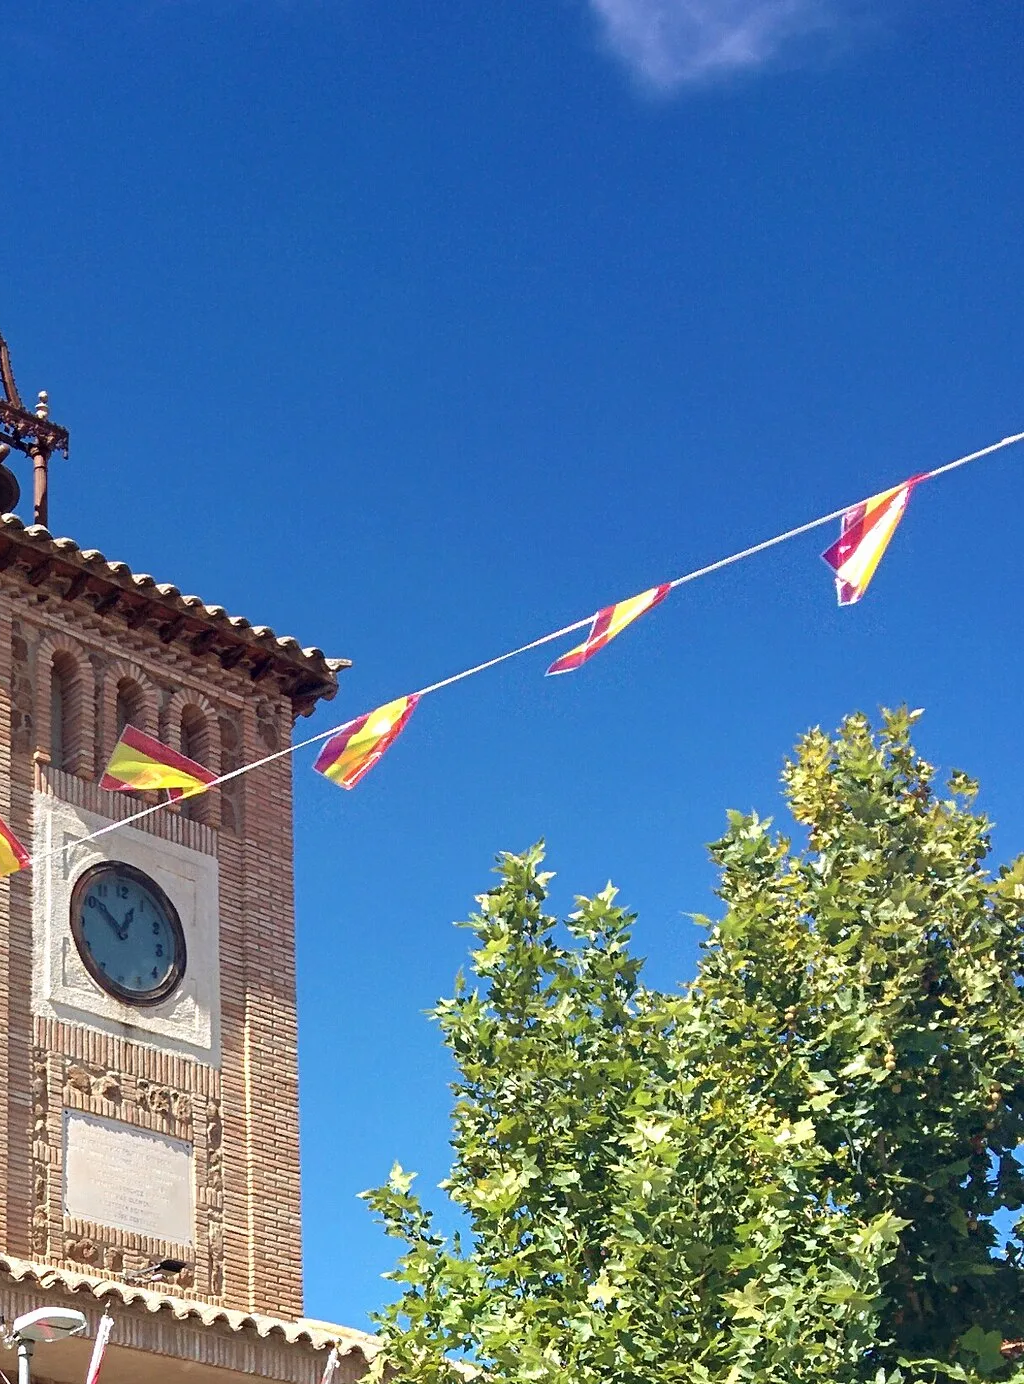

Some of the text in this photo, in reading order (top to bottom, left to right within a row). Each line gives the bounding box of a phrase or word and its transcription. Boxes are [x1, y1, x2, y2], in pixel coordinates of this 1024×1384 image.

[116, 885, 129, 900] 12
[152, 921, 160, 935] 2
[155, 943, 163, 957] 3
[151, 966, 159, 979] 4
